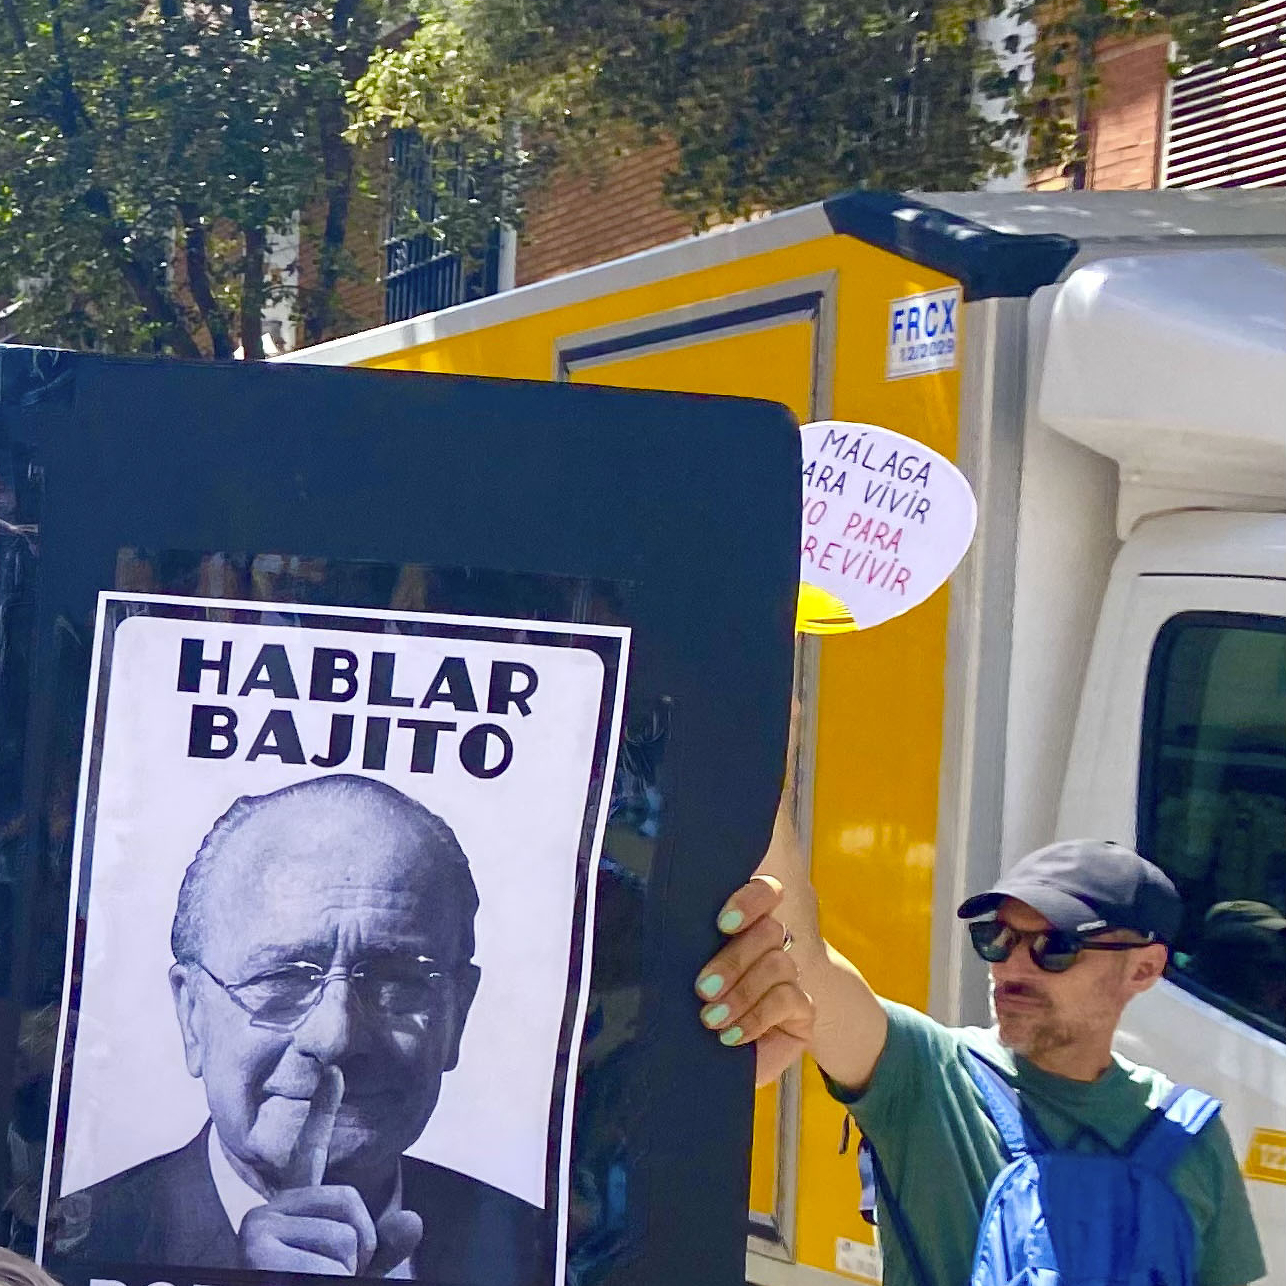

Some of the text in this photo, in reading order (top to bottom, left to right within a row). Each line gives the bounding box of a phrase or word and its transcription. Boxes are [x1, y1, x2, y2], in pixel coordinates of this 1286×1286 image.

[819, 429, 932, 488] MÁLAGA
[802, 460, 932, 525] ARA VIVIR
[802, 497, 904, 554] O PARA
[176, 638, 539, 719] HABLAR
[186, 703, 515, 780] BAJITO
